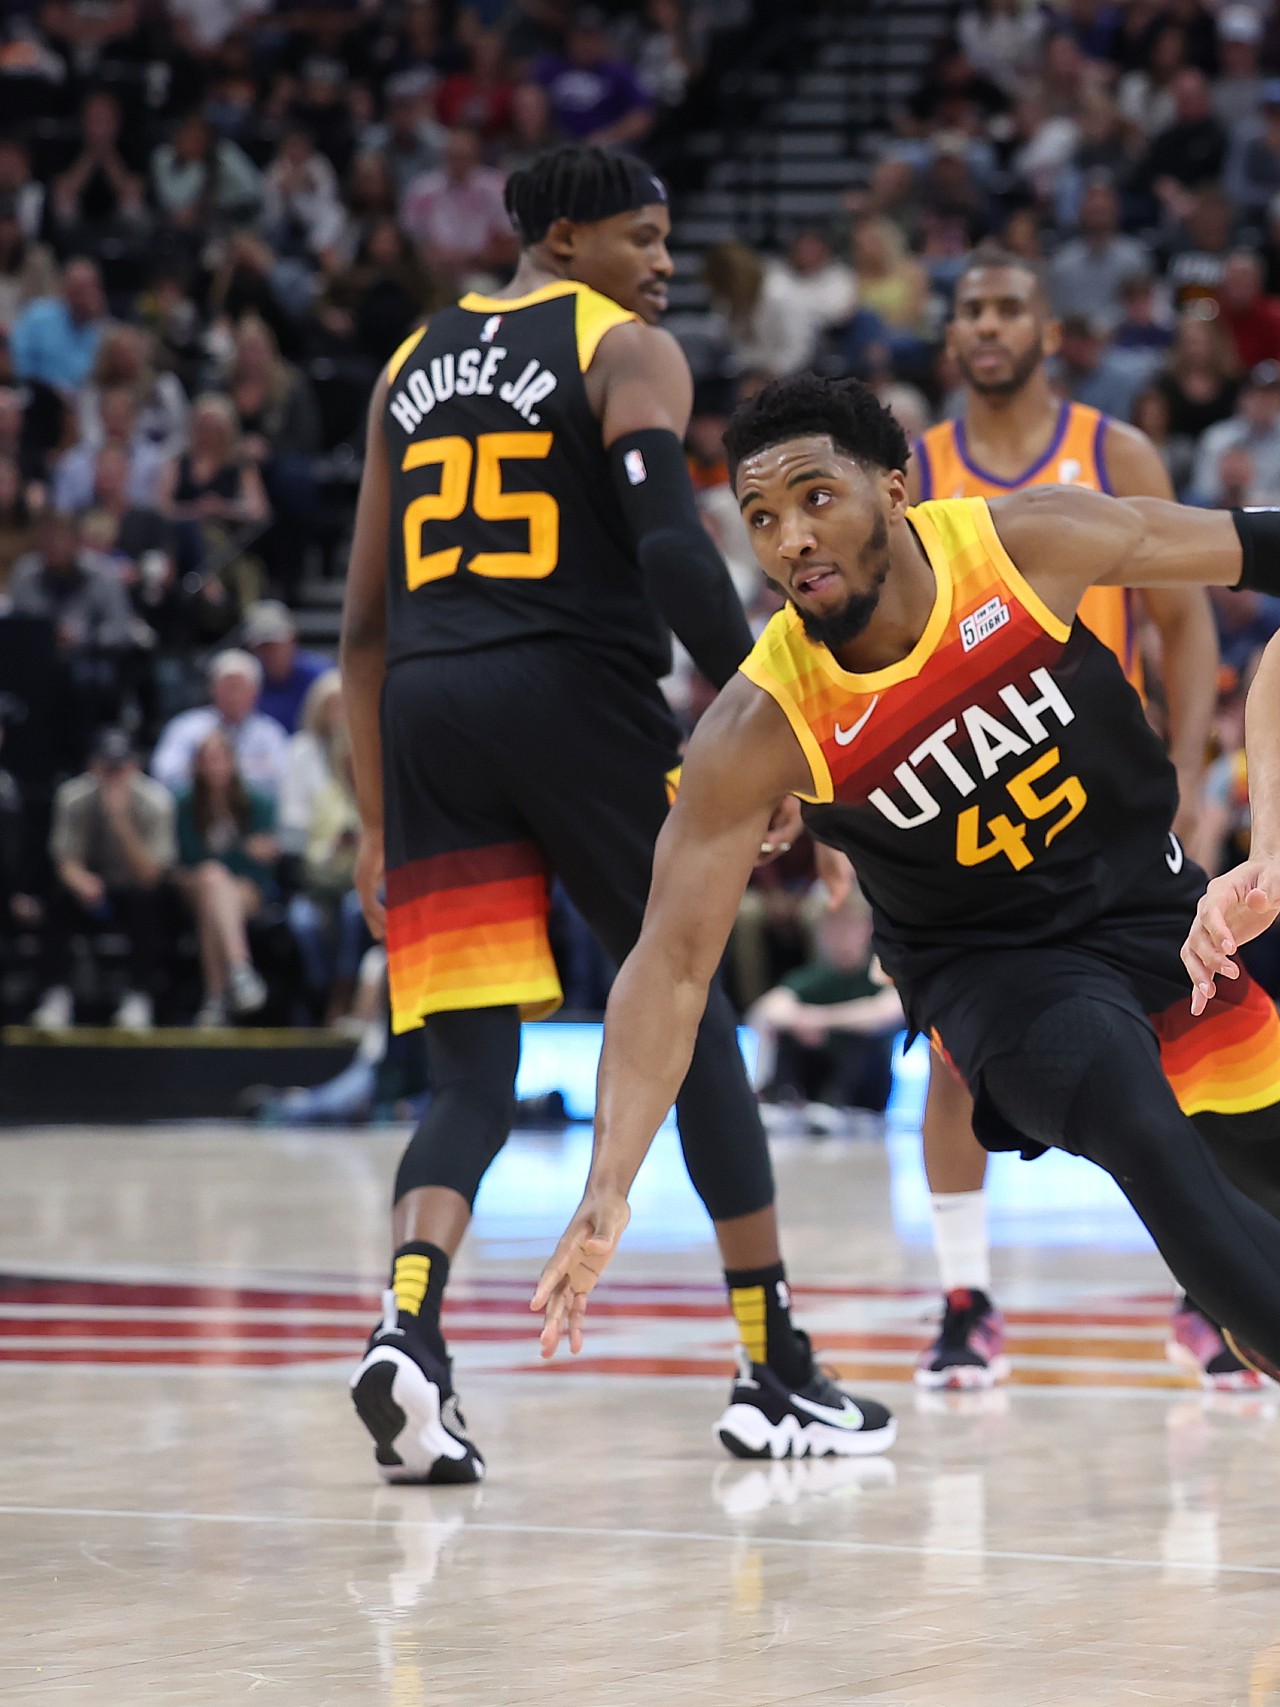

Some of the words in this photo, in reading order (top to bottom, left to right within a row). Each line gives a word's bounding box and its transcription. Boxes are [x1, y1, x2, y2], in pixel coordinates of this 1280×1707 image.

[390, 346, 507, 435] HOUSE
[499, 358, 558, 426] JR.
[402, 431, 560, 592] 25
[963, 620, 975, 646] 5
[980, 609, 1006, 636] FIGHT
[867, 666, 1076, 830] UTAH
[956, 745, 1088, 872] 45
